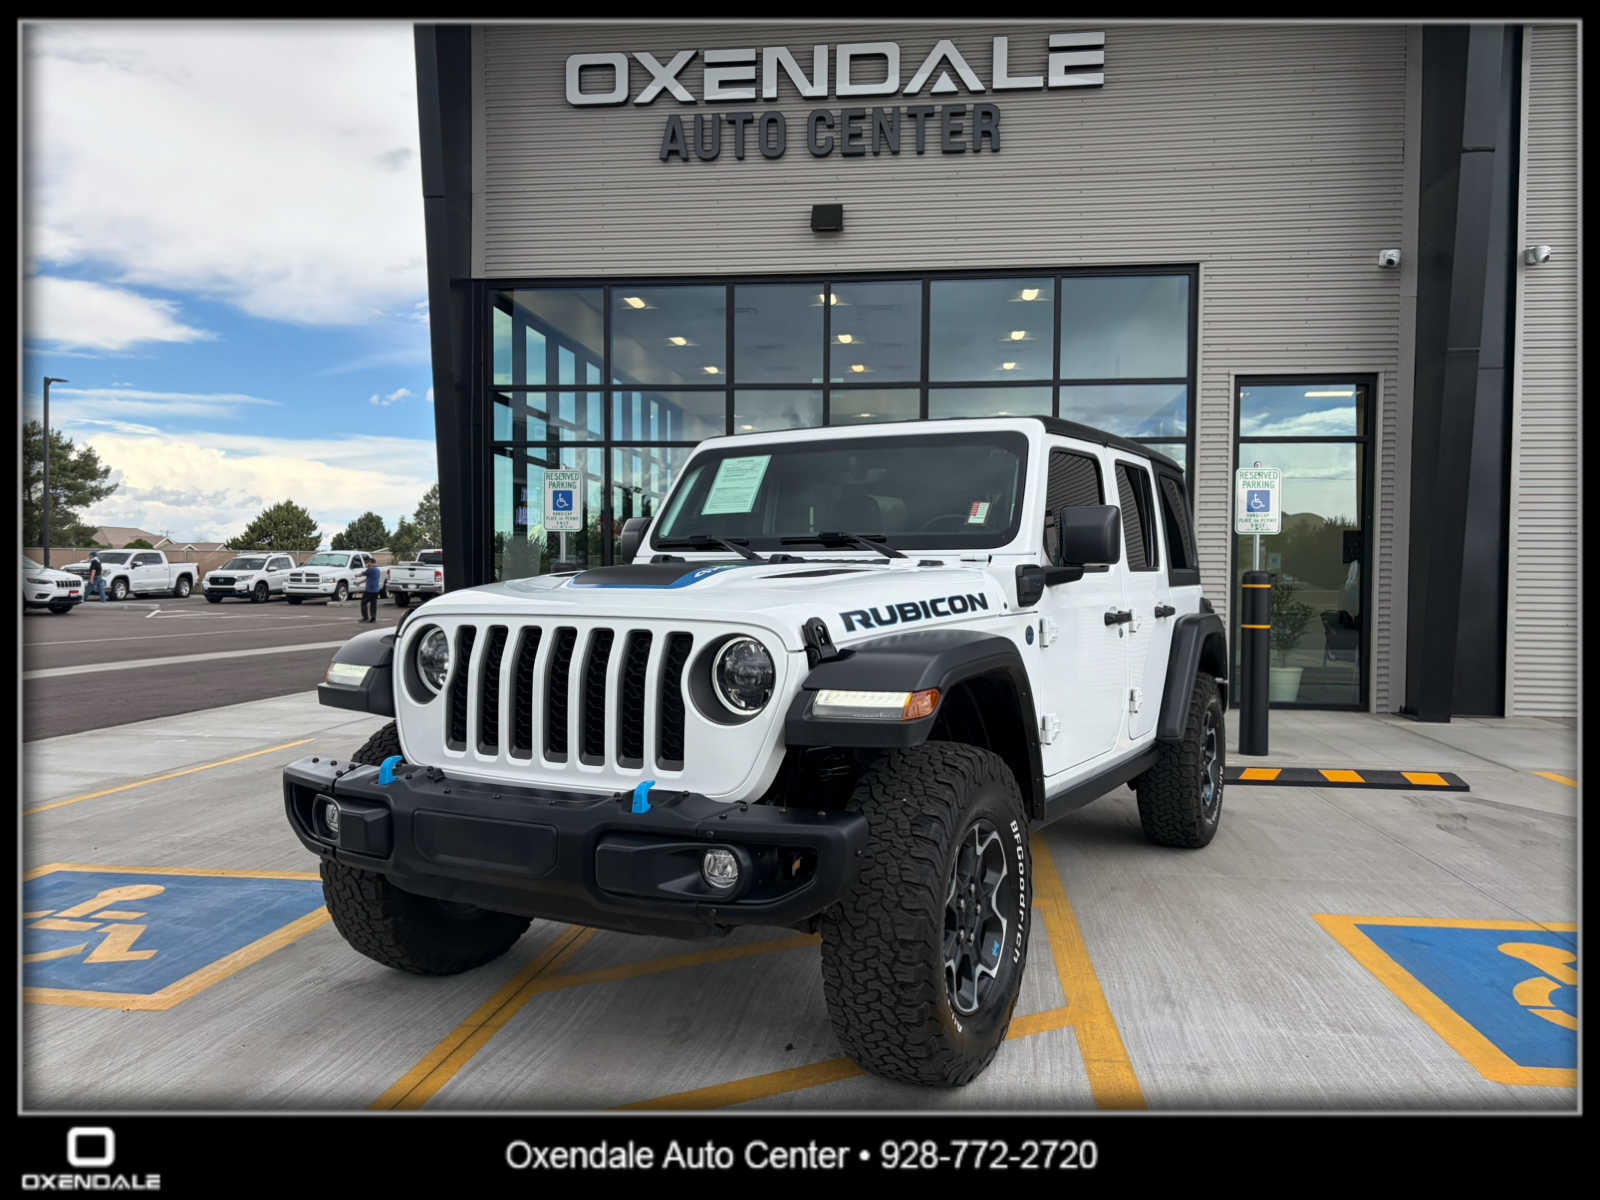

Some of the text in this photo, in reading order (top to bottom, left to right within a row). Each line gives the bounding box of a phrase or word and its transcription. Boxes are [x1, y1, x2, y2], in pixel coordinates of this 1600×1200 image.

[566, 32, 1105, 106] OXENDALE
[660, 103, 1000, 162] AUTO CENTER
[546, 472, 580, 480] RESERVED
[1239, 471, 1278, 480] RESERVED
[548, 481, 577, 489] PARKING
[1242, 480, 1275, 489] PARKING
[839, 592, 989, 633] RUBICON
